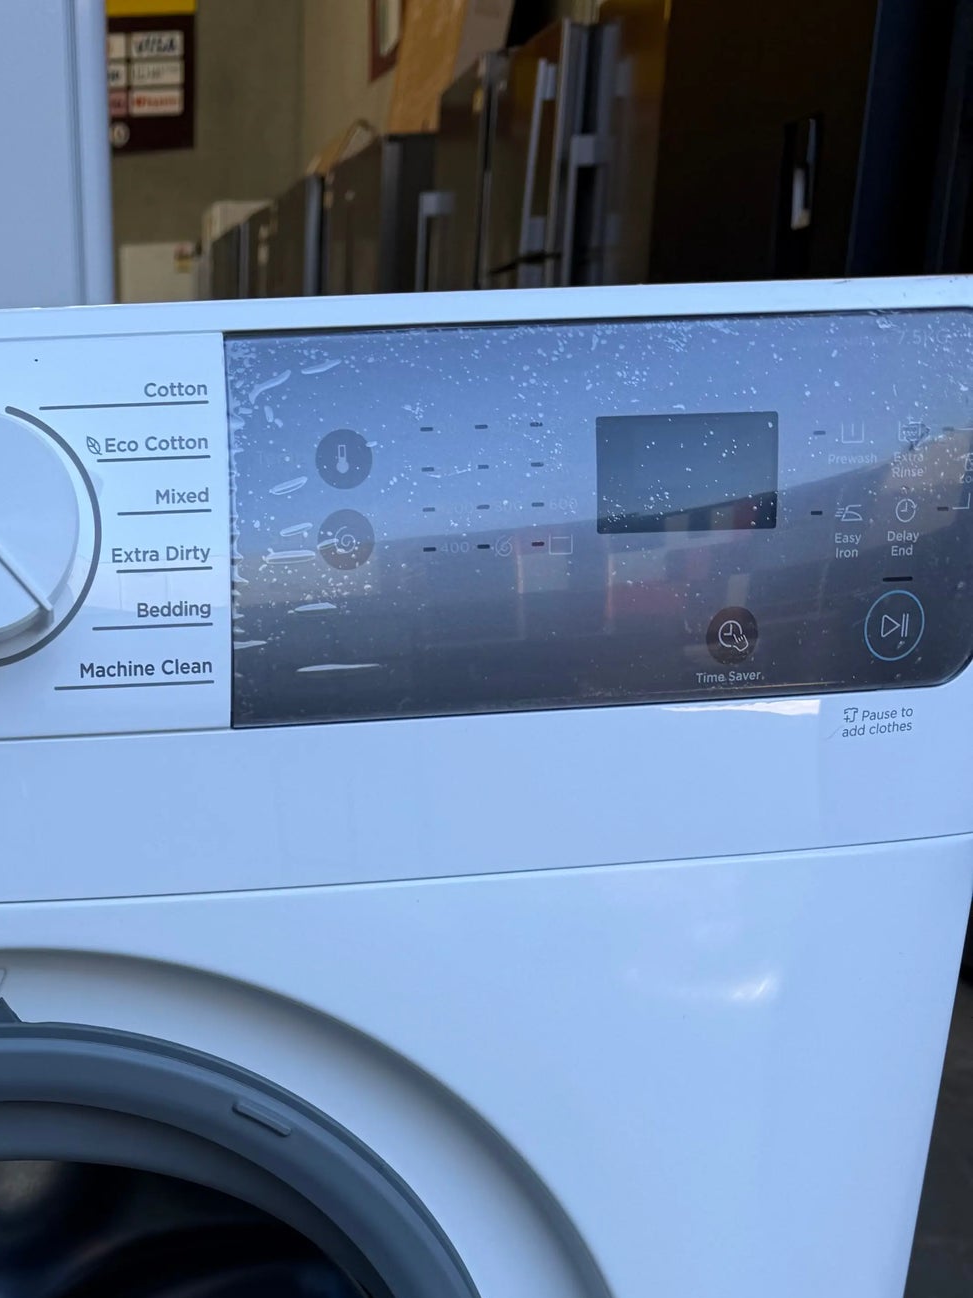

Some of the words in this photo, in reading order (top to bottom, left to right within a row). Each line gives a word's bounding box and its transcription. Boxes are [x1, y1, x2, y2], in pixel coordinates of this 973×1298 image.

[144, 382, 208, 398] Cotton
[105, 438, 139, 453] Eco
[145, 436, 209, 452] Cotton
[828, 453, 877, 465] Prewash
[893, 452, 924, 462] Extra
[892, 466, 924, 478] Rinse
[156, 487, 209, 504] Mixed
[835, 533, 862, 545] Easy
[887, 531, 920, 542] Delay
[440, 541, 470, 553] 400
[835, 548, 859, 558] Iron
[891, 545, 914, 556] End
[112, 547, 160, 564] Extra
[166, 546, 211, 565] Dirty
[137, 601, 211, 620] Bedding
[80, 661, 155, 679] Machine
[162, 659, 213, 675] Clean
[696, 672, 725, 684] Time
[728, 671, 761, 682] Saver
[861, 709, 897, 722] Pause
[901, 707, 914, 718] to
[842, 725, 865, 738] add
[868, 721, 913, 735] clothes
